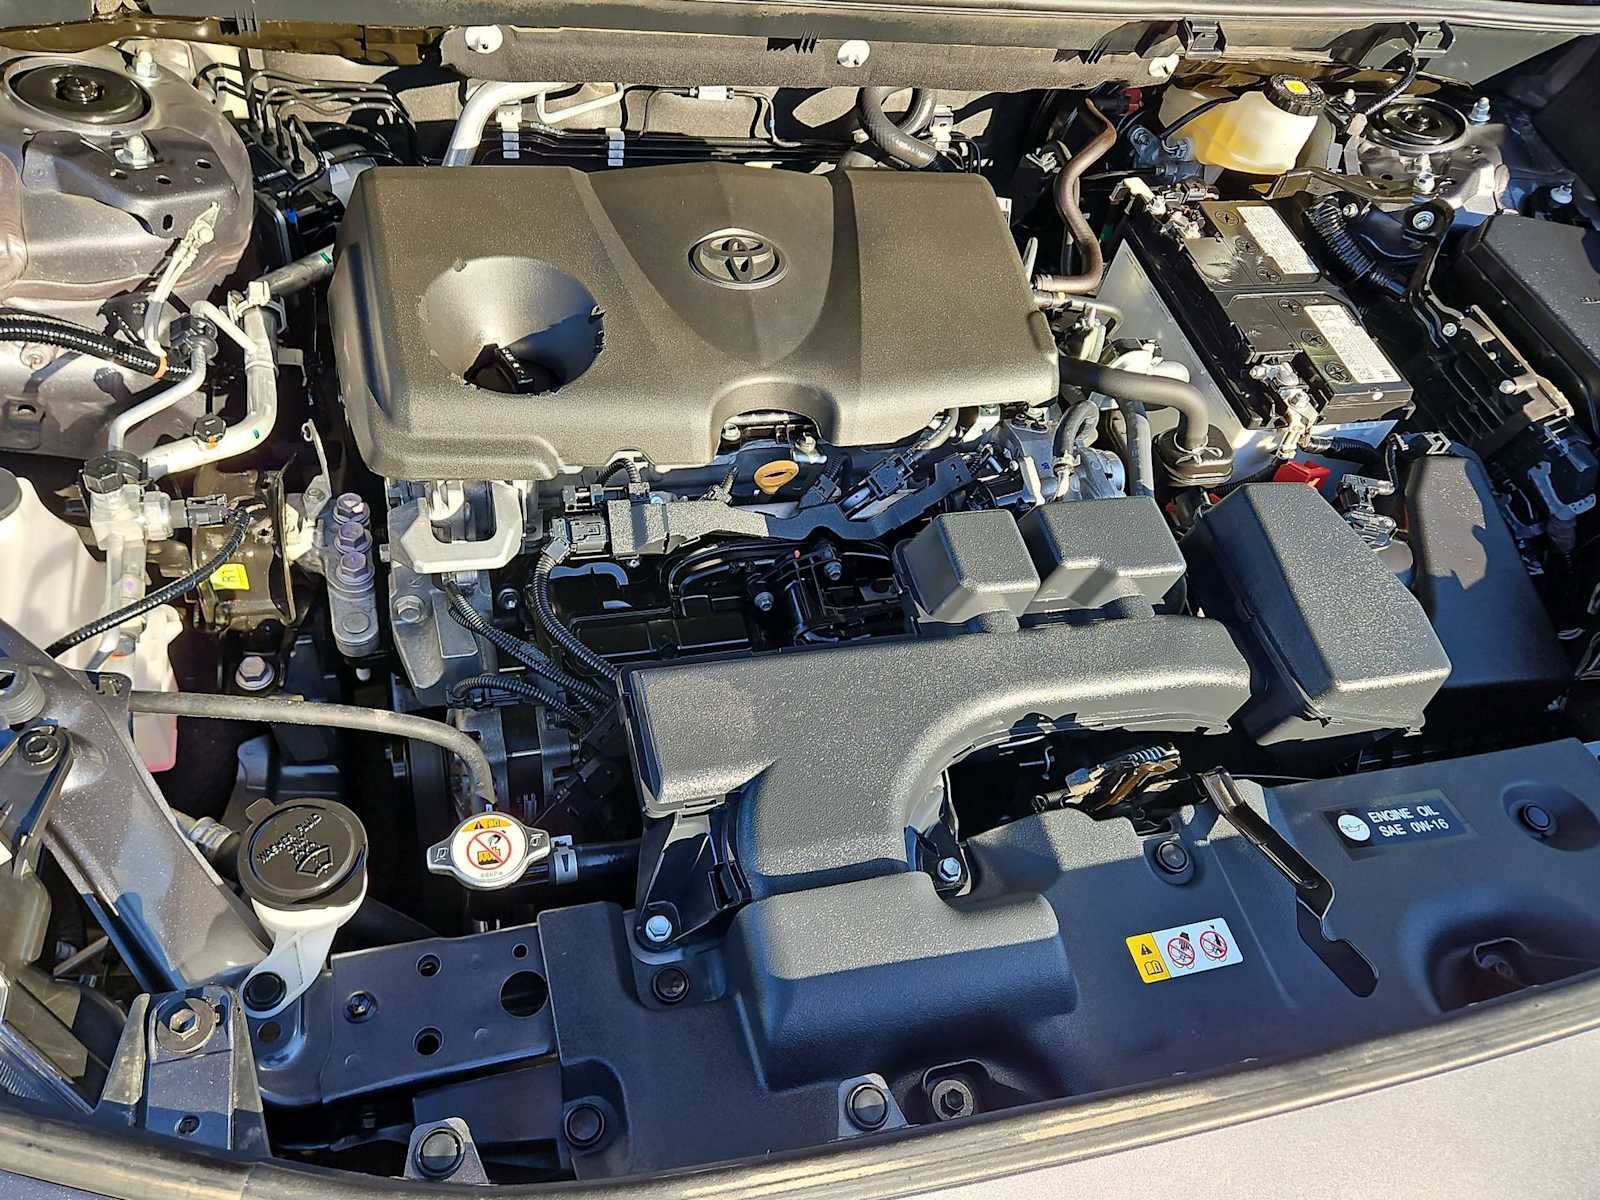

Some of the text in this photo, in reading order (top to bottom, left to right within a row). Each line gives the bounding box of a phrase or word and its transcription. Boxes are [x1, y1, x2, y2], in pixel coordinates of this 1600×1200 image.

[1367, 805, 1440, 823] ENGINE OIL
[1378, 818, 1449, 837] SAE 0W-16
[256, 832, 297, 864] WASHER
